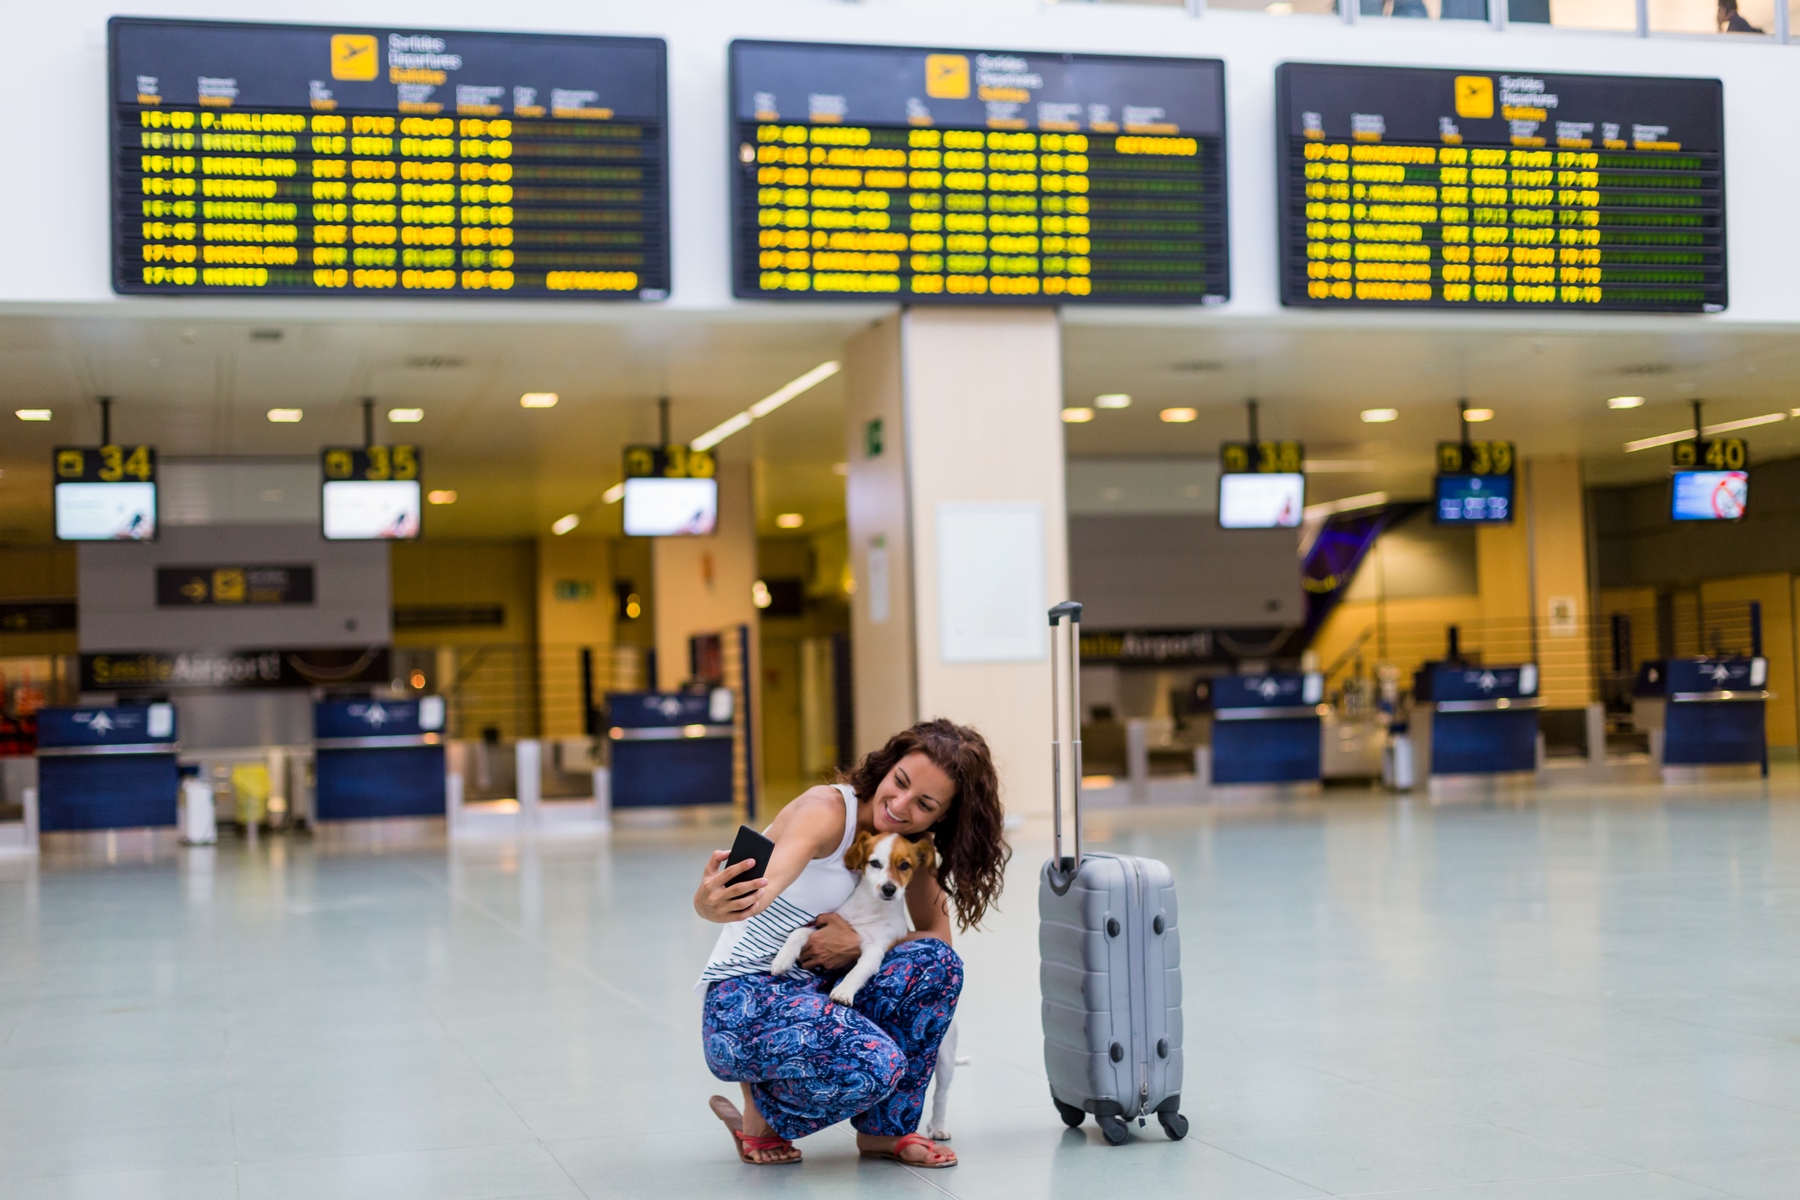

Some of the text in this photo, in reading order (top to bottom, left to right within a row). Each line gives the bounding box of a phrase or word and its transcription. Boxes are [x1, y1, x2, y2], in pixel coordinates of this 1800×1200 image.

[98, 444, 151, 482] 34
[365, 446, 419, 482] 35
[664, 444, 715, 478] 36
[1472, 440, 1513, 475] 39
[1705, 438, 1746, 471] 40
